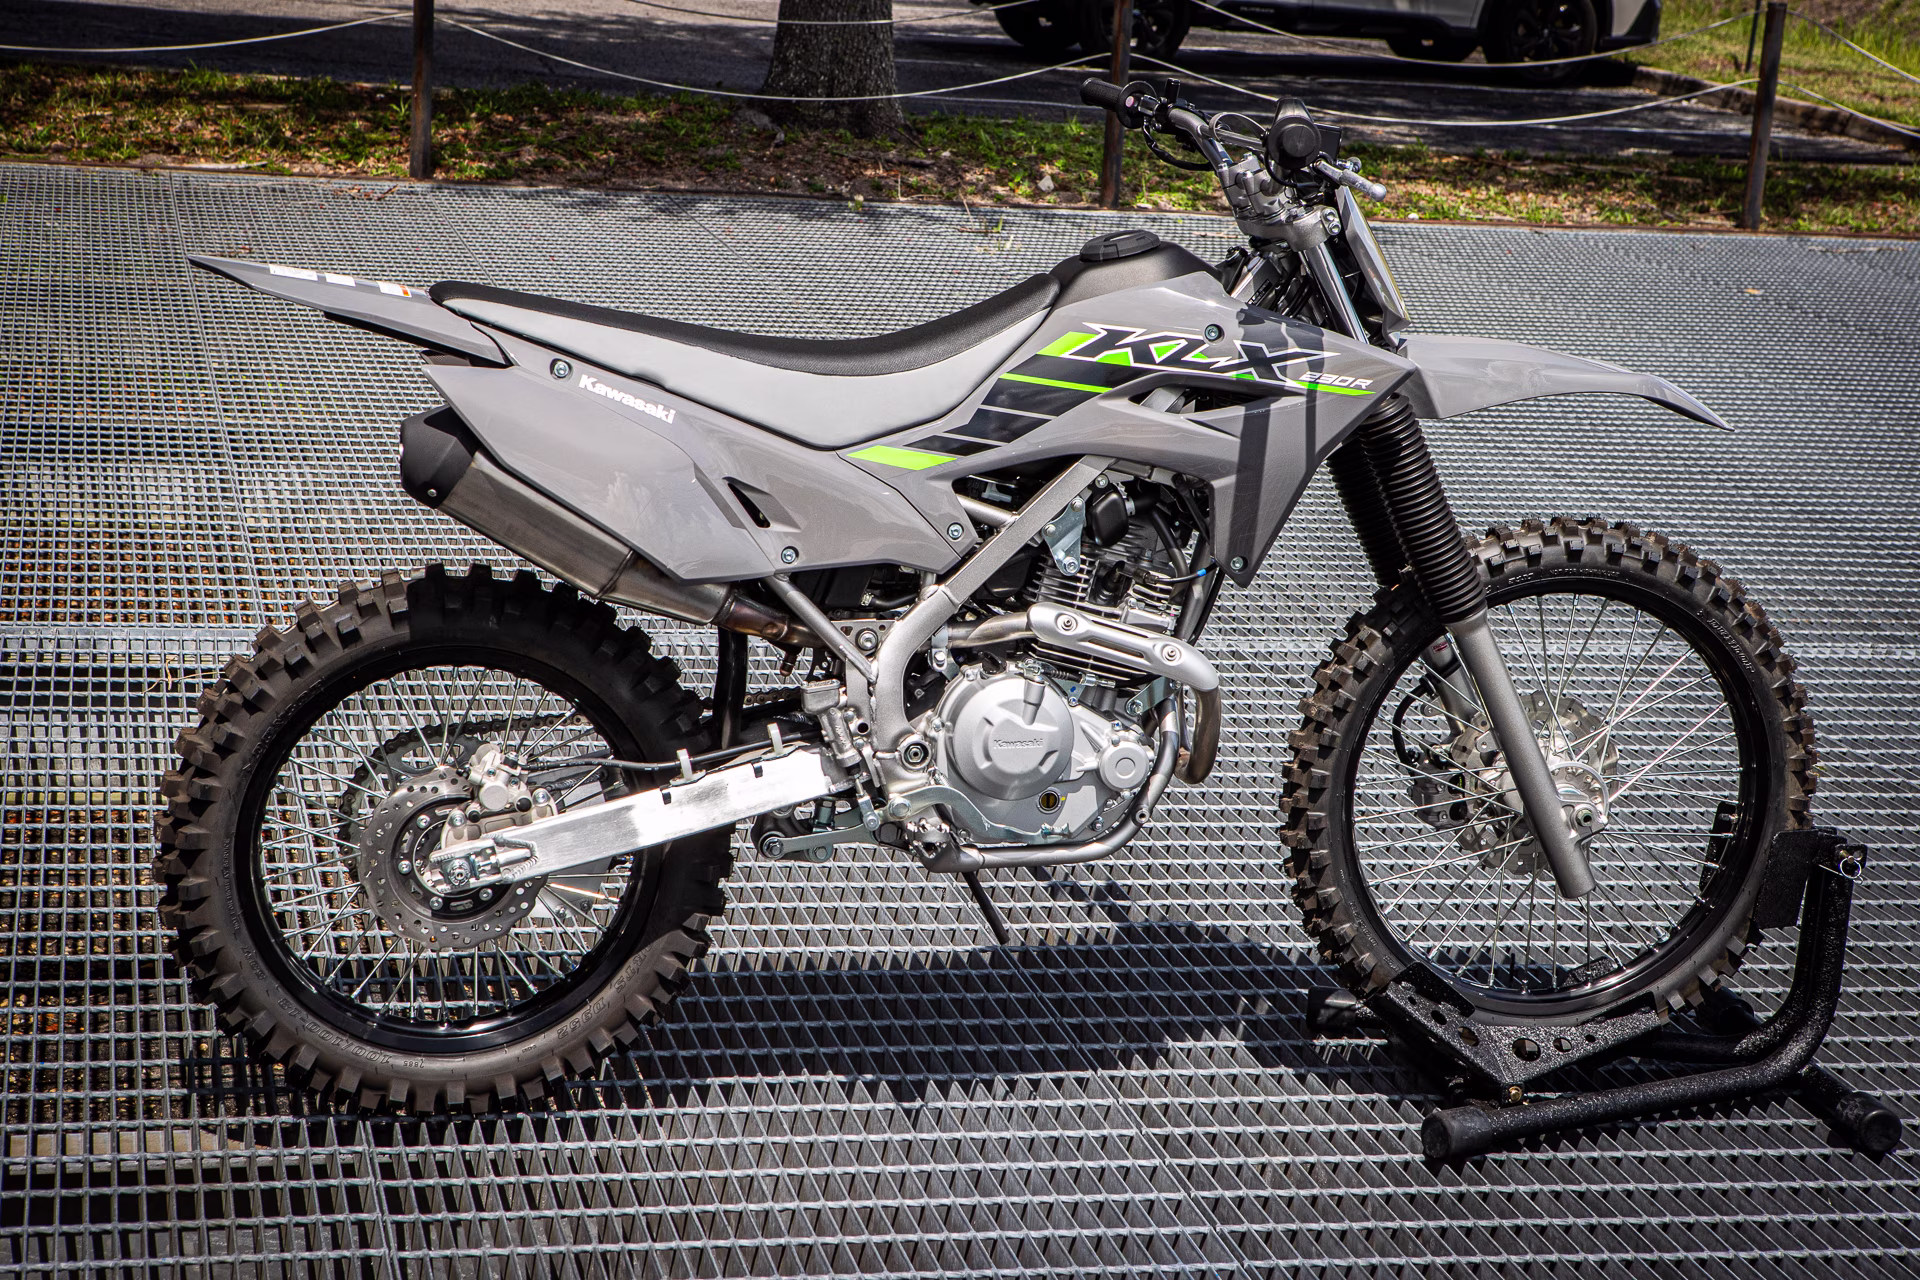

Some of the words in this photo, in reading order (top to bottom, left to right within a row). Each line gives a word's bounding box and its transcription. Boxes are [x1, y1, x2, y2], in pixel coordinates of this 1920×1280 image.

[1059, 322, 1341, 390] KLX
[1299, 371, 1374, 389] 230R
[578, 374, 676, 424] Kawasaki
[994, 739, 1043, 749] Kawasaki
[556, 997, 607, 1040] D952
